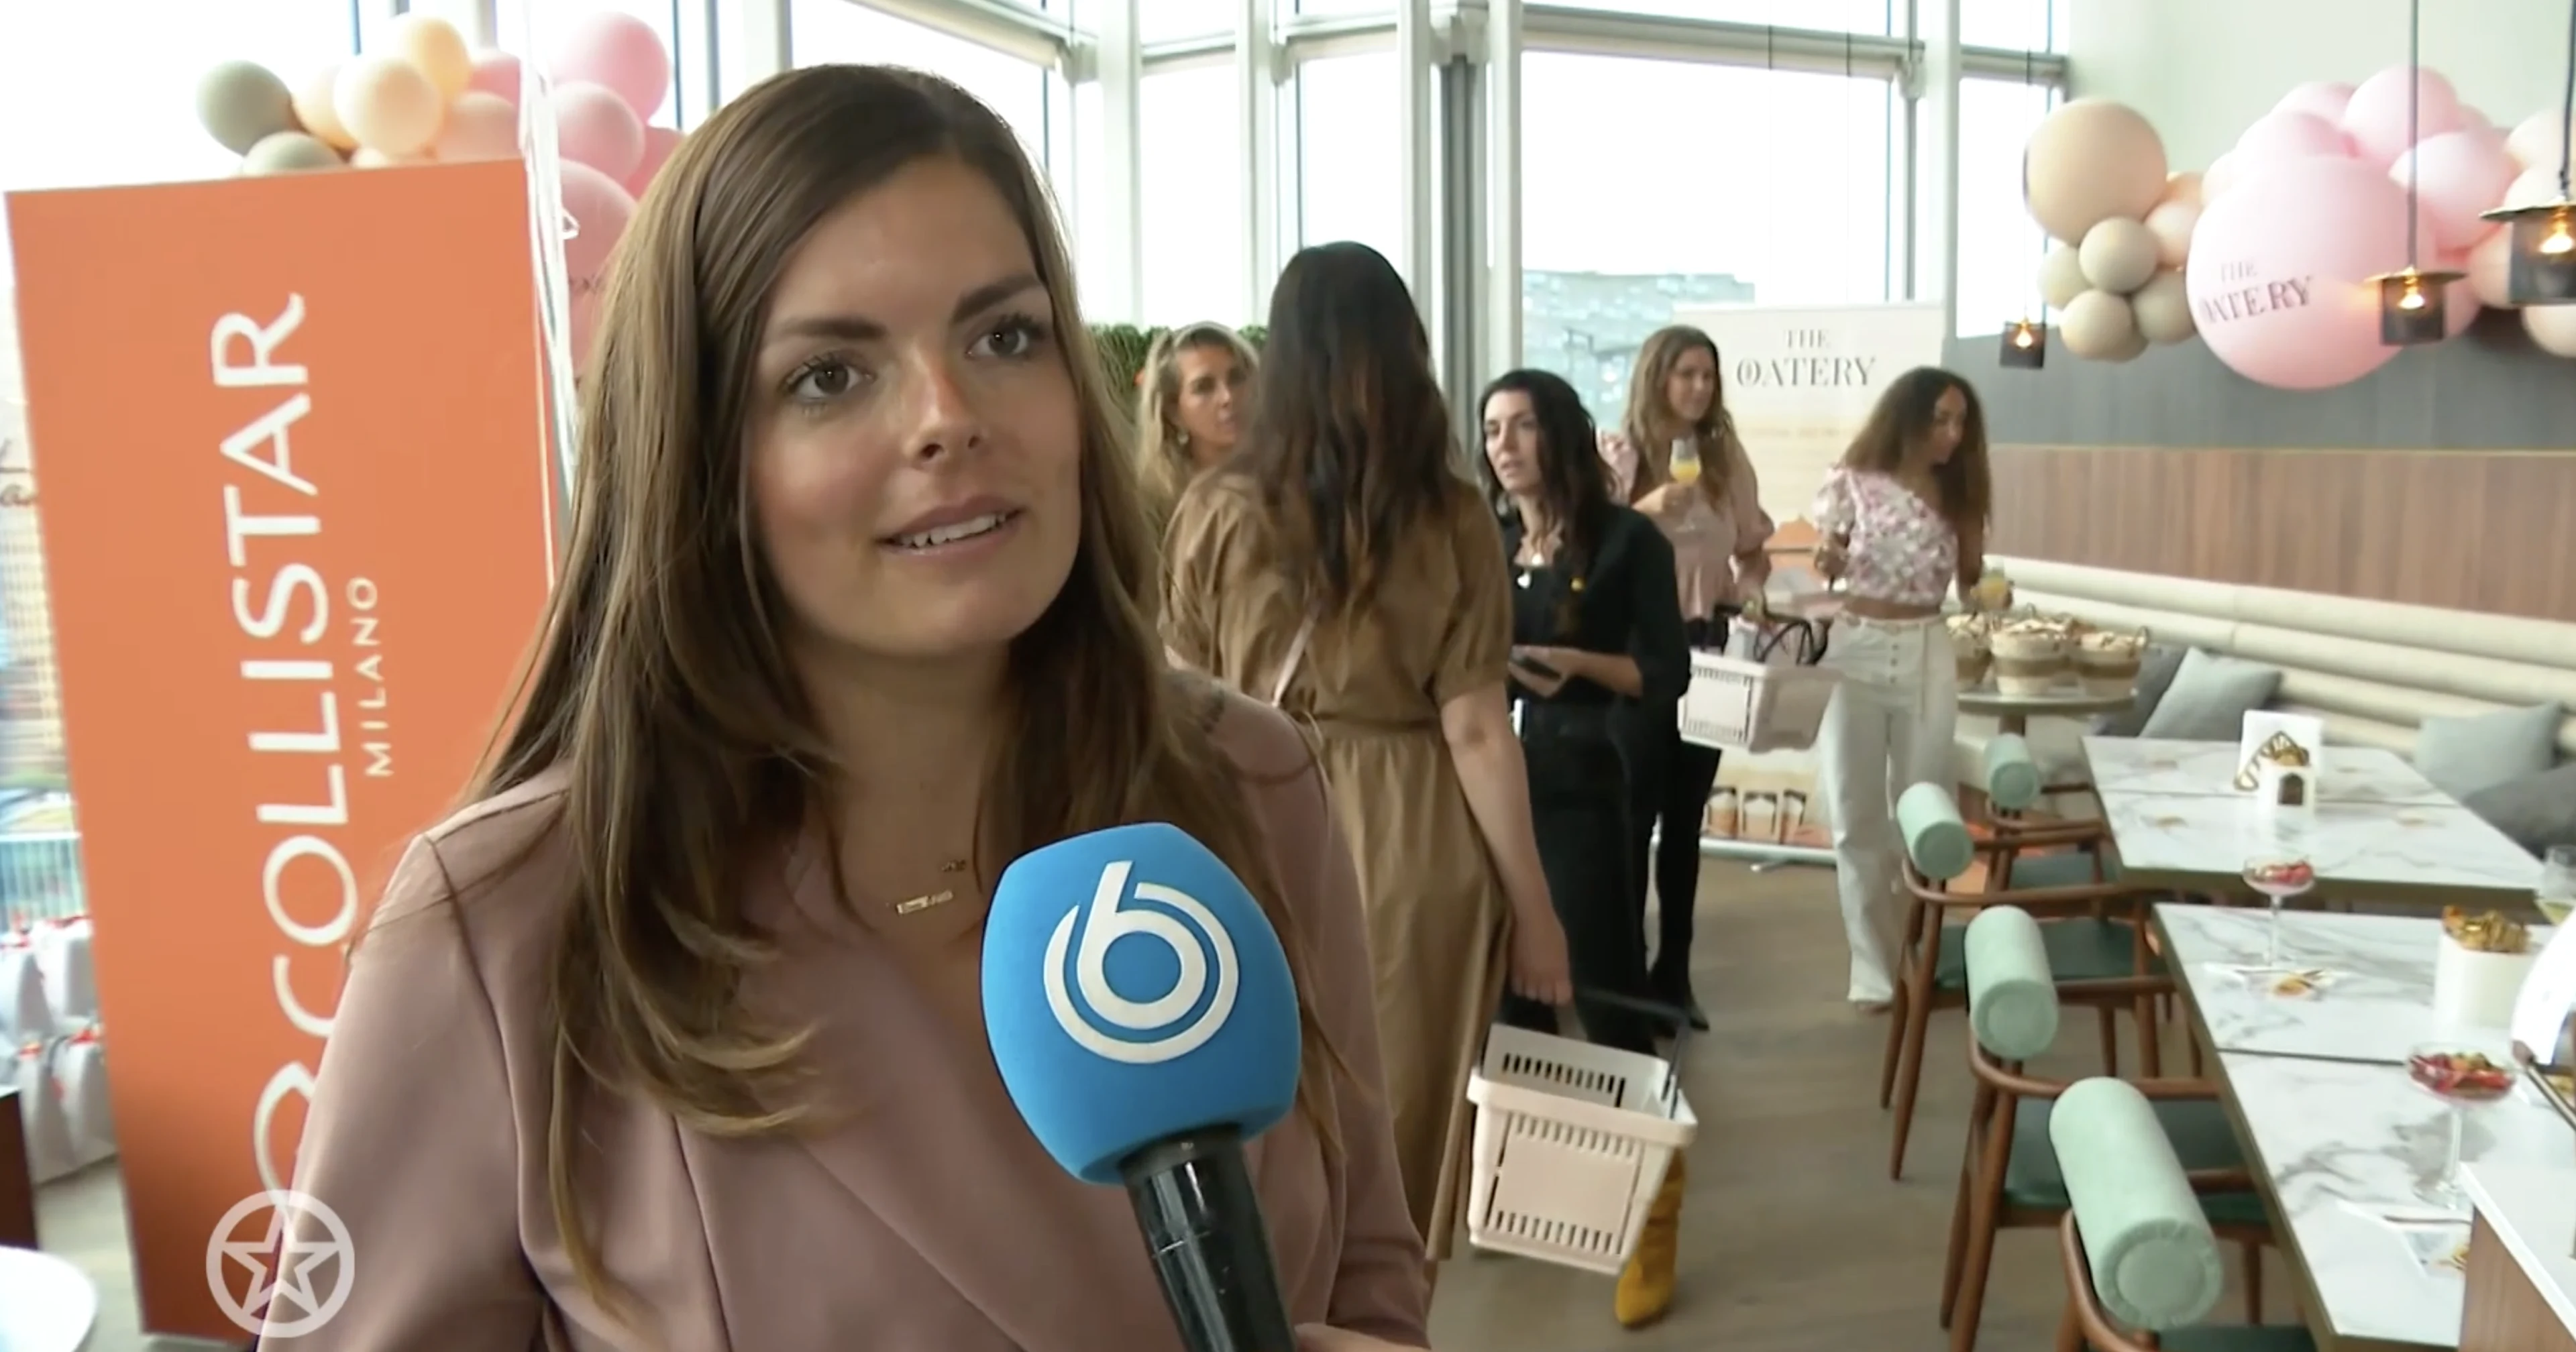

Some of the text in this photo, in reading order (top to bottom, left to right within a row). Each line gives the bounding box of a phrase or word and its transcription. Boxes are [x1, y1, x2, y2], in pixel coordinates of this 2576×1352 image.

[1737, 356, 1876, 387] OATERY
[1785, 329, 1831, 348] THE
[211, 292, 359, 1038] COLLISTAR
[346, 577, 394, 777] MILANO
[1076, 860, 1208, 1030] 6
